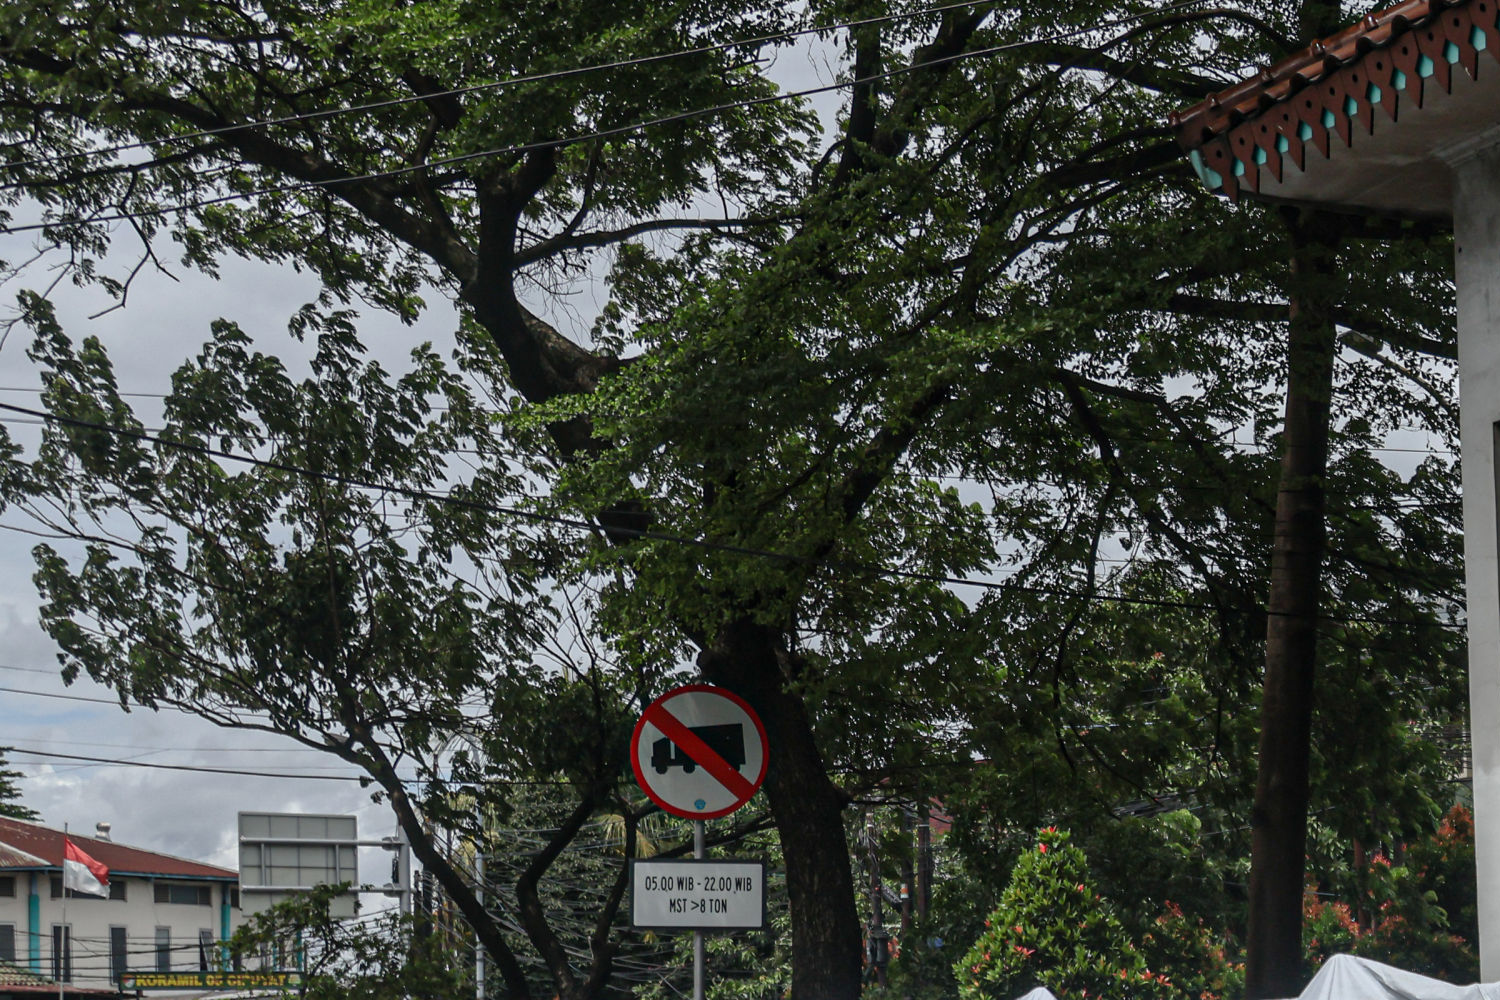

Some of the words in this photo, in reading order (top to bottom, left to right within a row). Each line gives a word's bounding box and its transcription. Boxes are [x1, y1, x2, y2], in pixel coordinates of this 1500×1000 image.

[645, 876, 674, 892] 05.00
[677, 876, 694, 891] WIB
[704, 876, 732, 892] 22.00
[735, 876, 752, 892] WIB
[669, 898, 687, 913] MST
[709, 898, 728, 913] TON
[136, 974, 202, 988] KORAMIL
